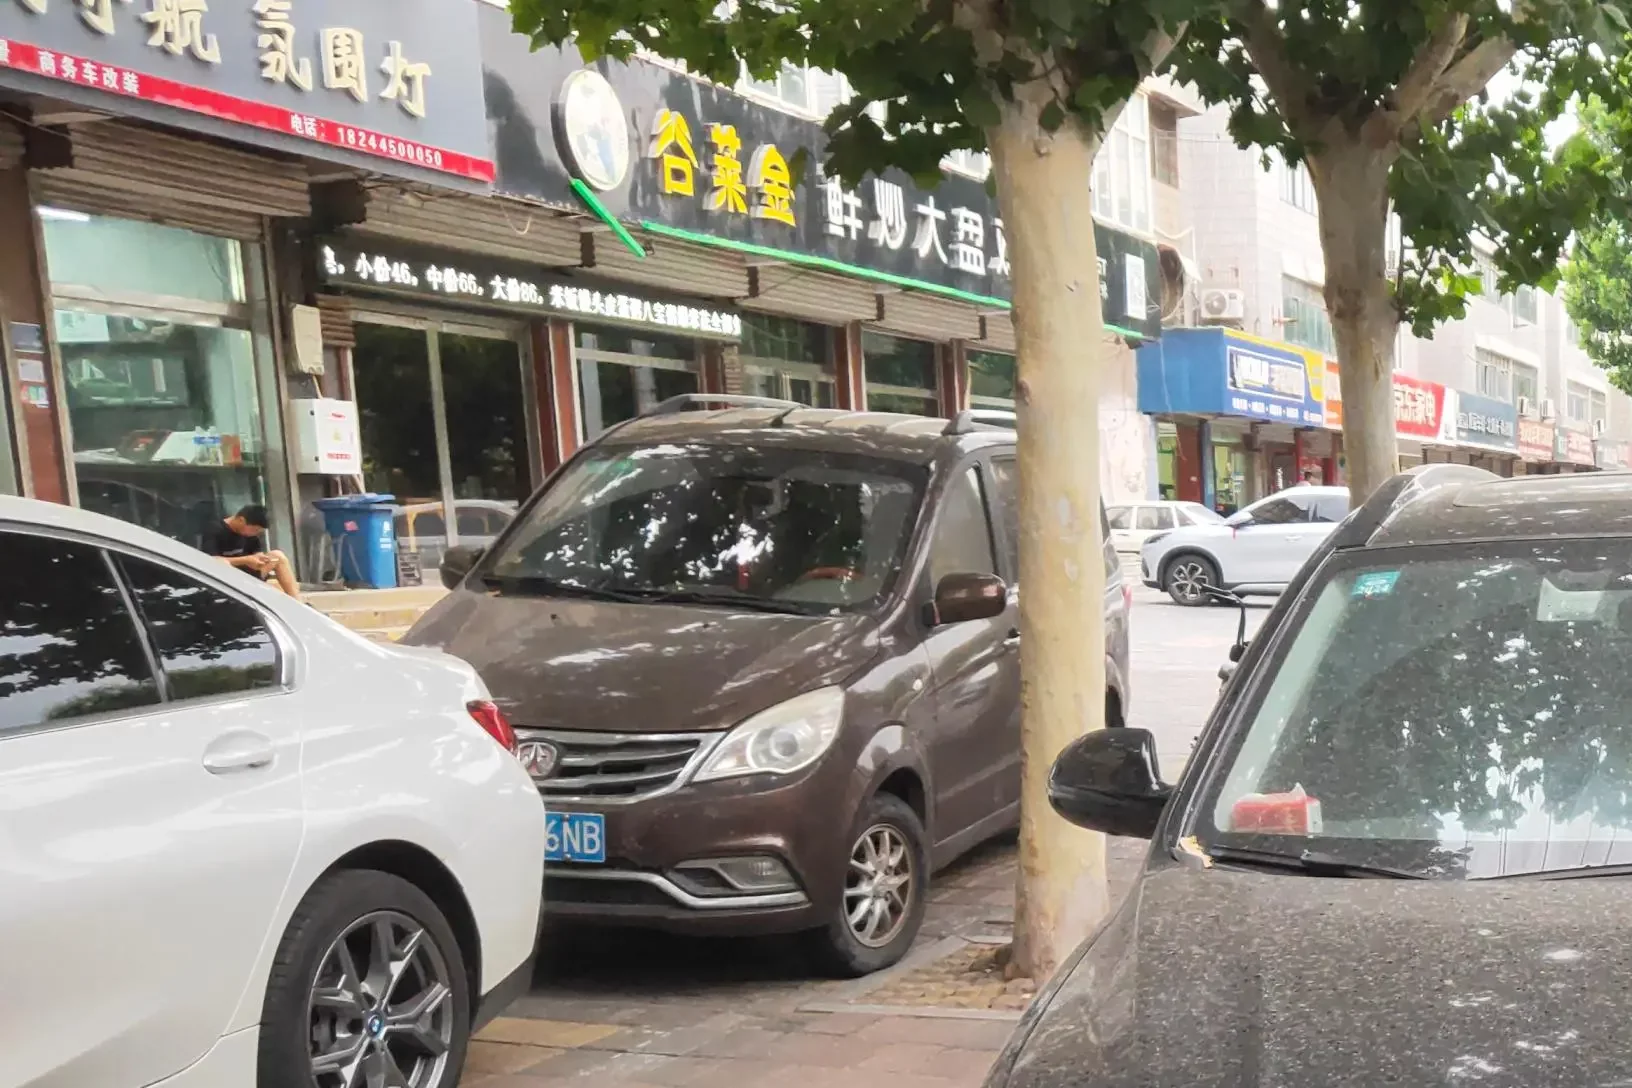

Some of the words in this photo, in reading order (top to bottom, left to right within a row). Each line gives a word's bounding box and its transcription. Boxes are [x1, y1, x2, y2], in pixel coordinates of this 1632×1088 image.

[37, 50, 140, 95] 商务车改装
[337, 127, 443, 166] 18244500050
